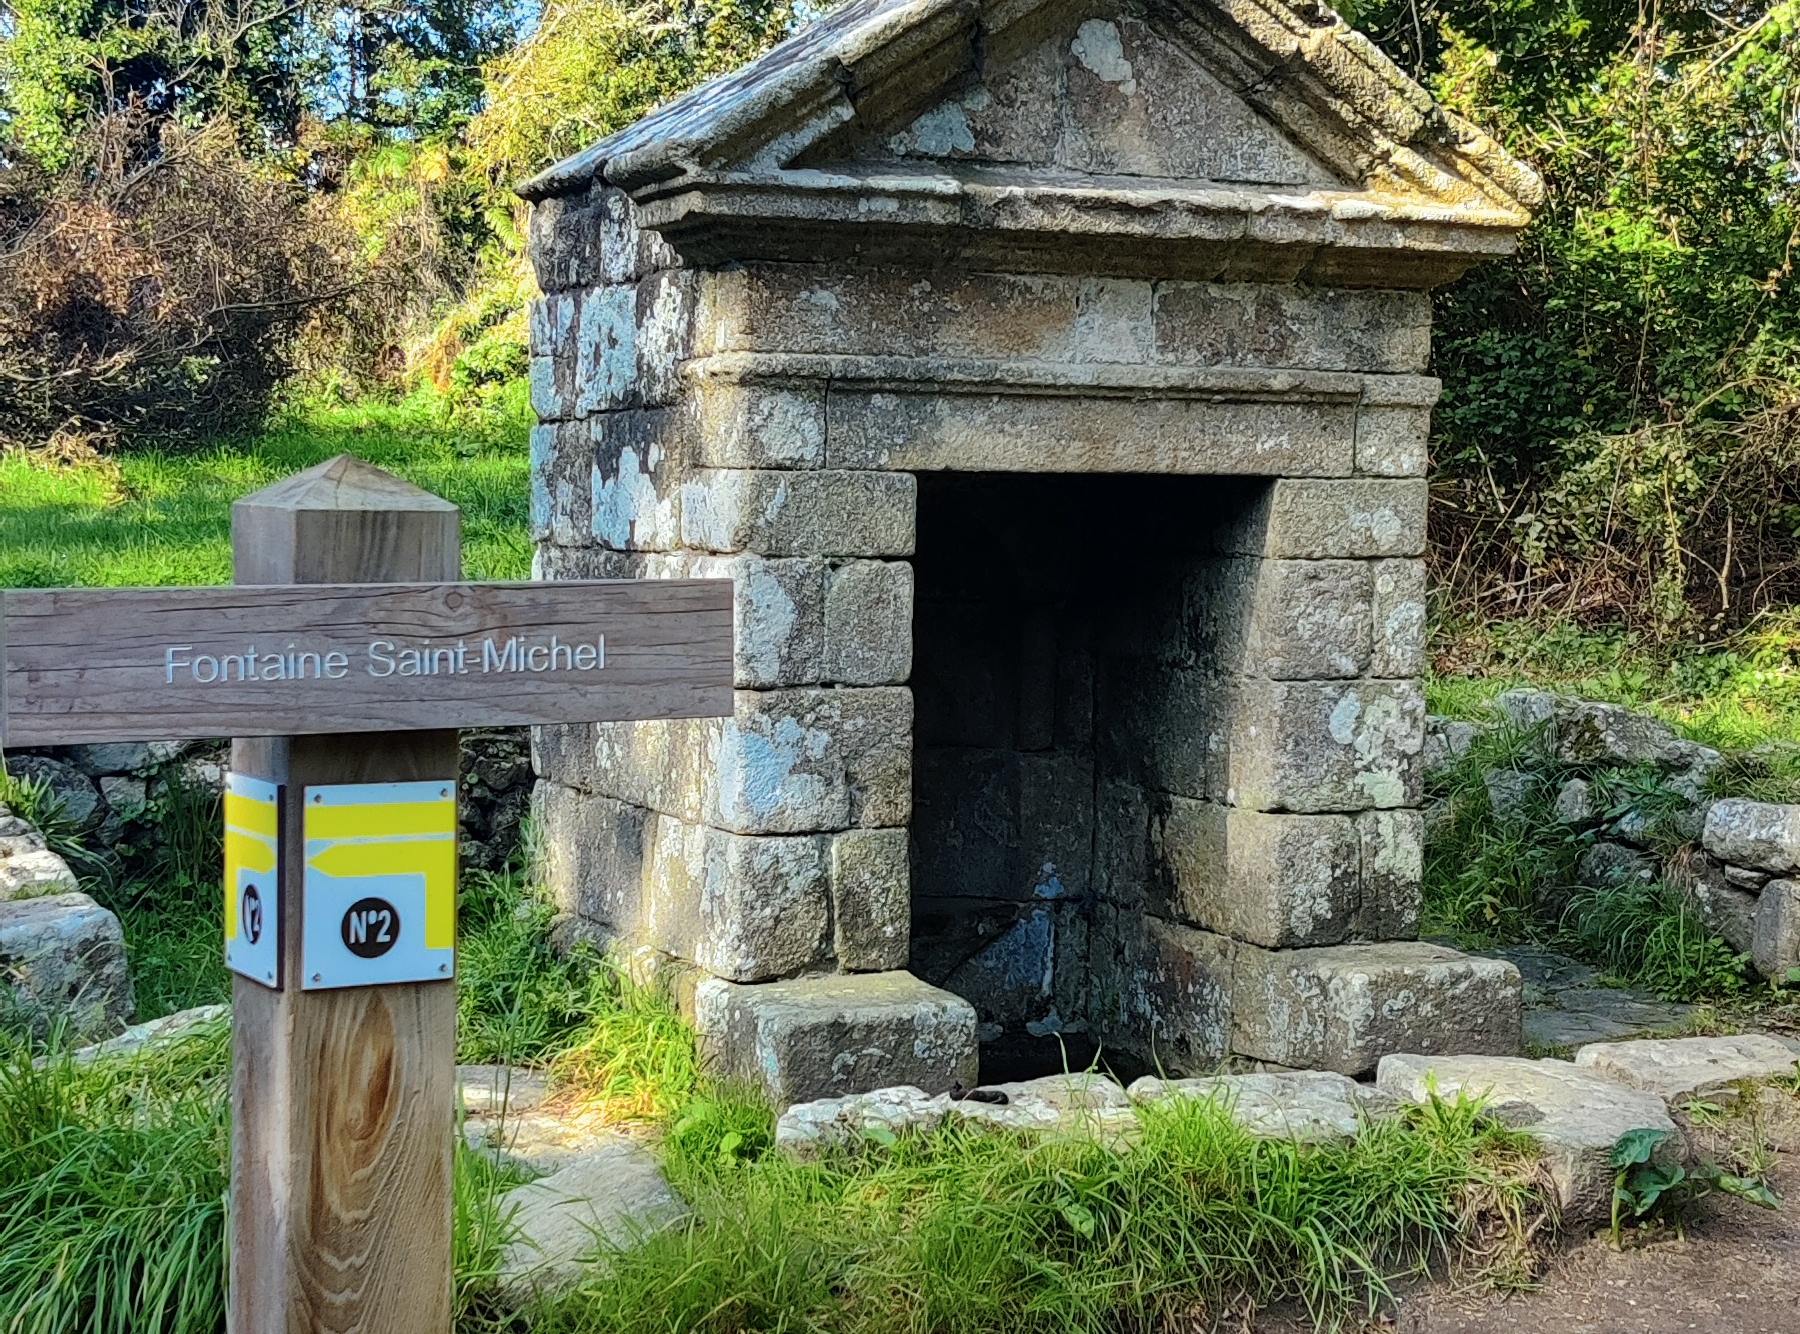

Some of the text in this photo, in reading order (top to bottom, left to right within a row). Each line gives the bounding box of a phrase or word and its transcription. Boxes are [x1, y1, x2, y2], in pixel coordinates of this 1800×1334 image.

[165, 632, 606, 684] Fontaine Saint-Michel
[349, 909, 391, 944] N°2
